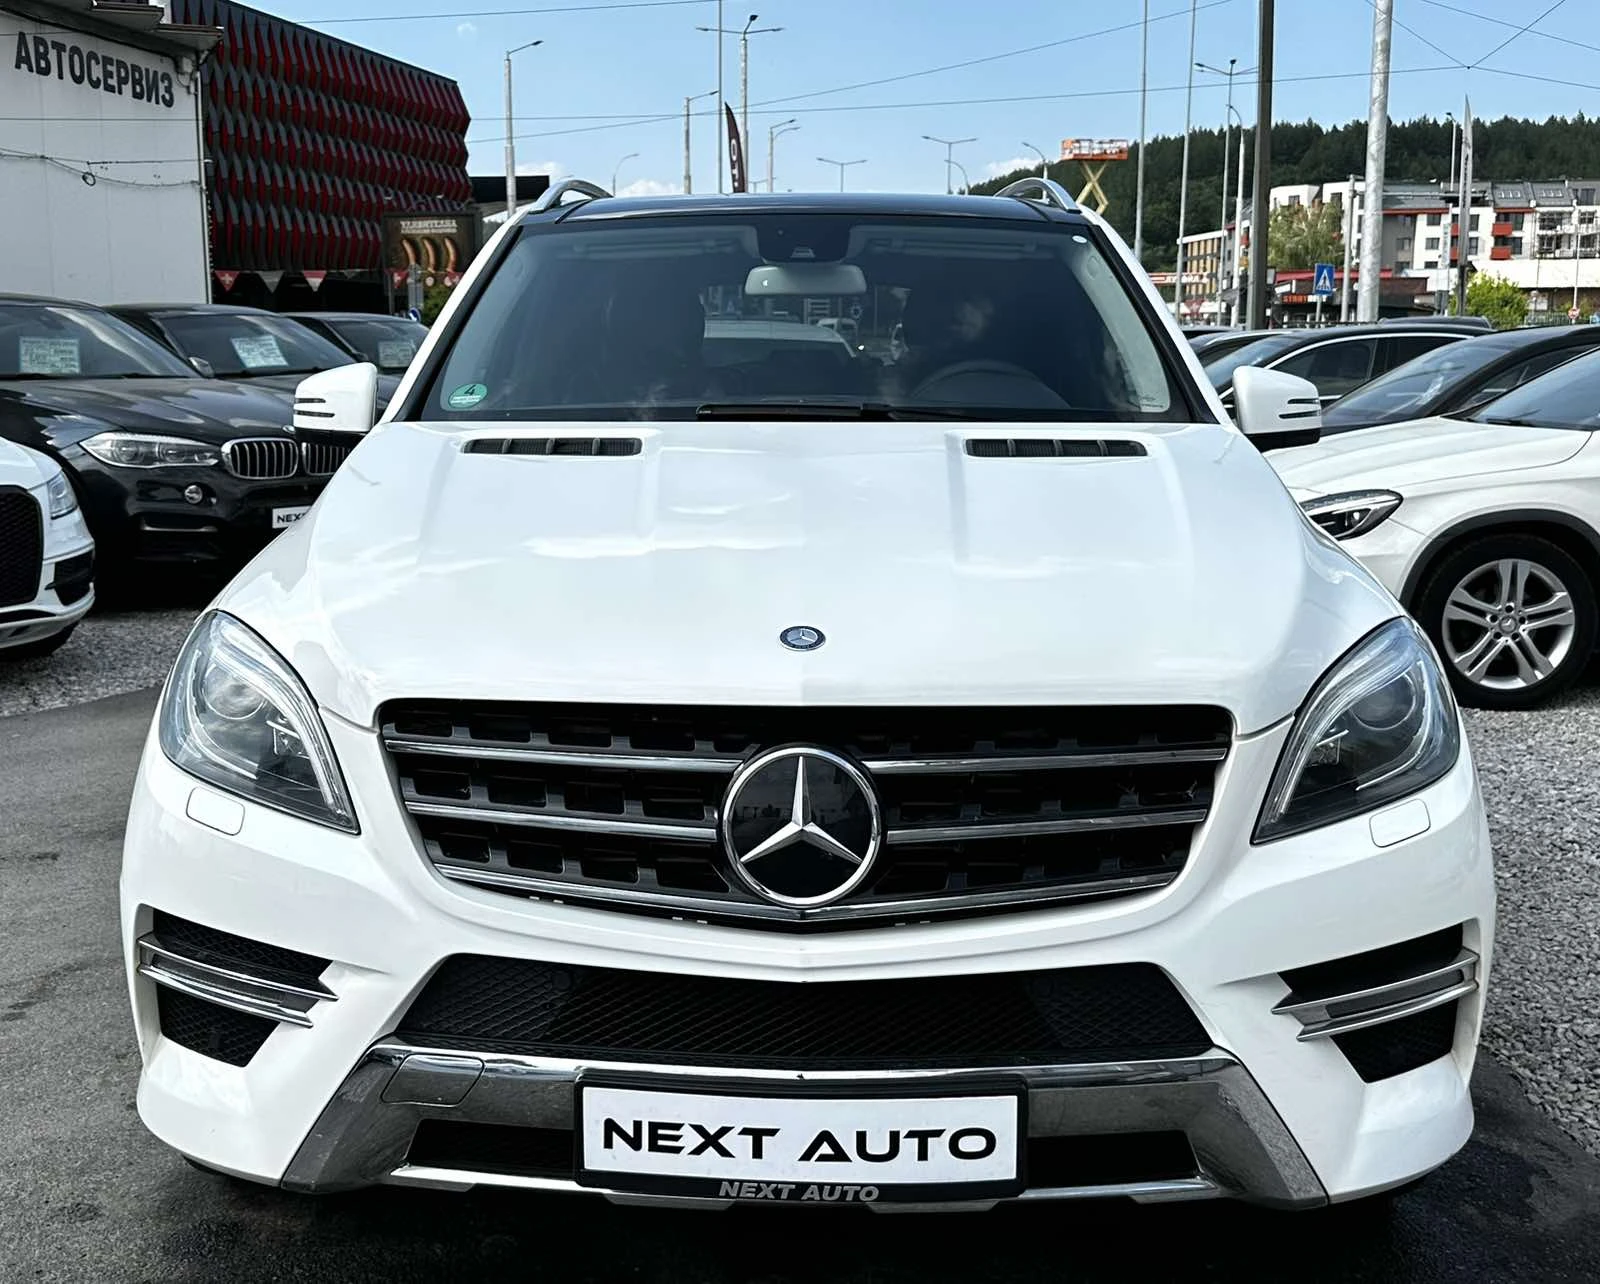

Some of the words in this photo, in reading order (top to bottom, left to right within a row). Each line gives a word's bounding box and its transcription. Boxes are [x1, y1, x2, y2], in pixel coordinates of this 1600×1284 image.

[15, 31, 175, 108] АВТОСЕРВИЗ
[464, 384, 477, 396] 4
[603, 1117, 780, 1160] NEXT
[798, 1127, 997, 1163] AUTO
[718, 1181, 795, 1201] NEXT
[801, 1184, 880, 1203] AUTO
